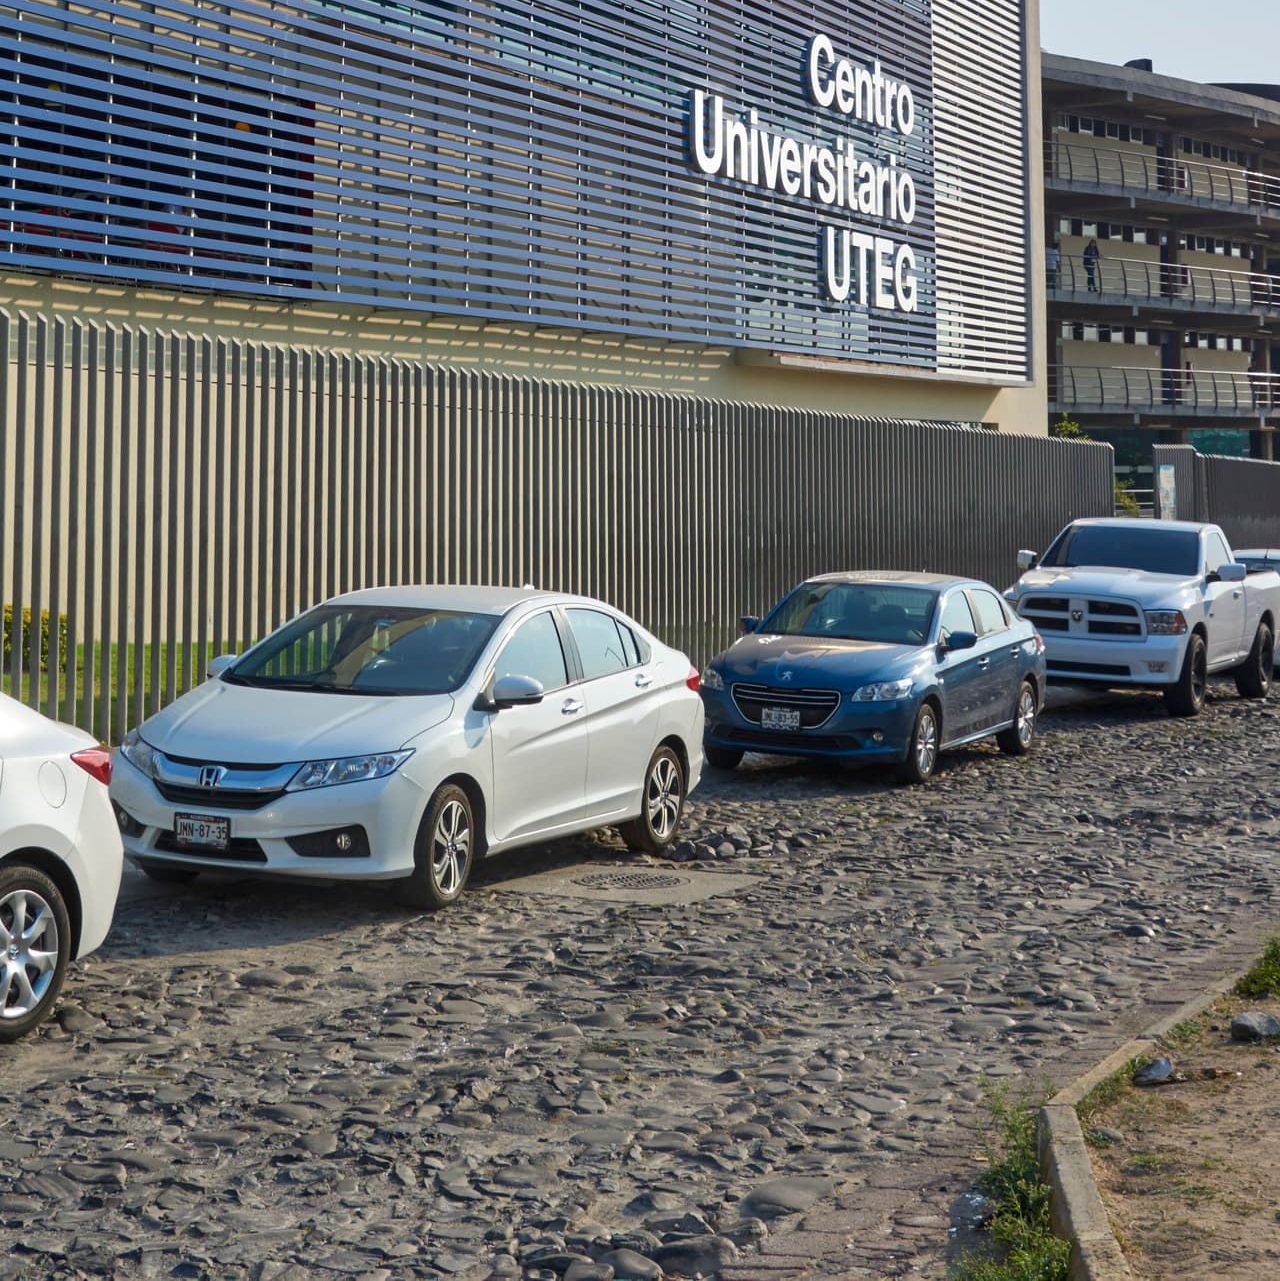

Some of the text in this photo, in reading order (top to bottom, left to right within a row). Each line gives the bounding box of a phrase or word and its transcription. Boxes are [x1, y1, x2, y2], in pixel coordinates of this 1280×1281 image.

[807, 33, 915, 136] Centro
[689, 88, 916, 224] Universitario
[823, 225, 918, 312] UTEG
[177, 821, 227, 840] JMN-87-35
